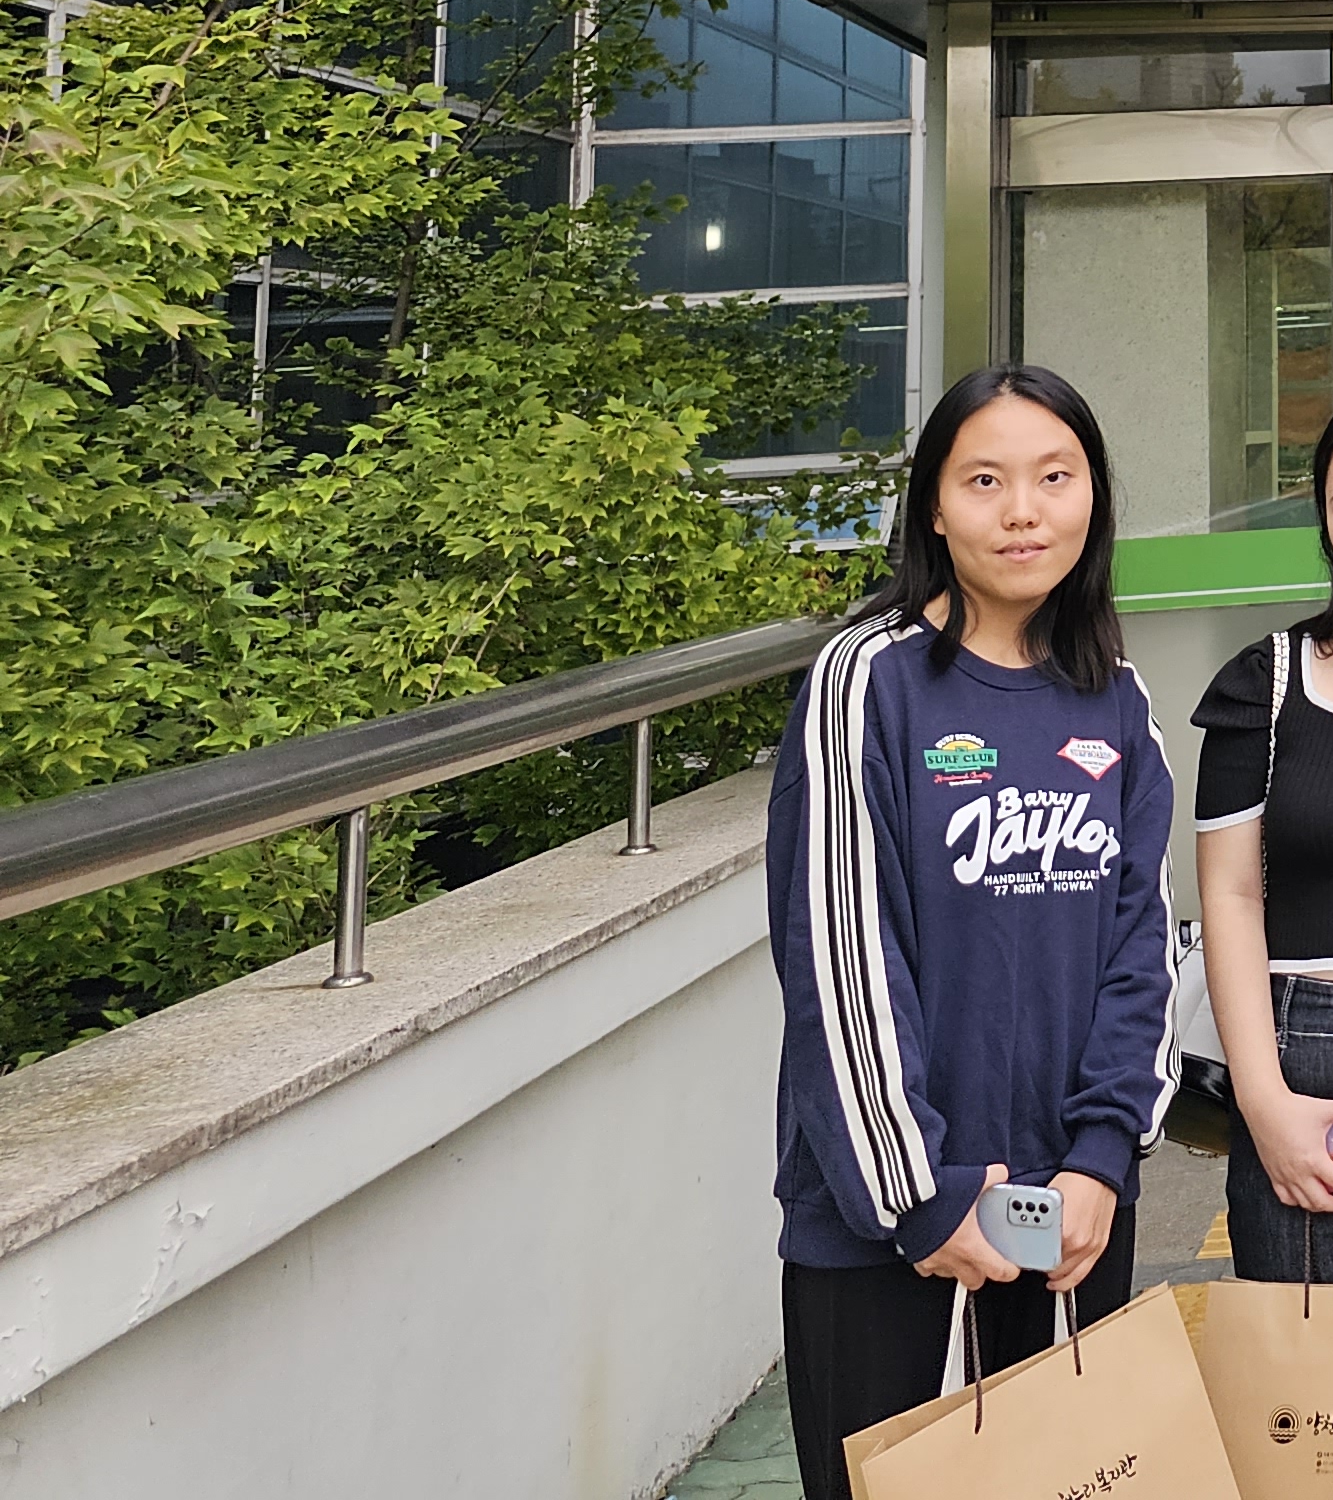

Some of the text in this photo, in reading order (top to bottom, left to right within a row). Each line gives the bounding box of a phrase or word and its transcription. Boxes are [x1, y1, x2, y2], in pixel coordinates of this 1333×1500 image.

[927, 752, 995, 765] SURF CLUB
[996, 786, 1073, 821] Barry
[993, 880, 1094, 897] 77 NORTH NOWRA
